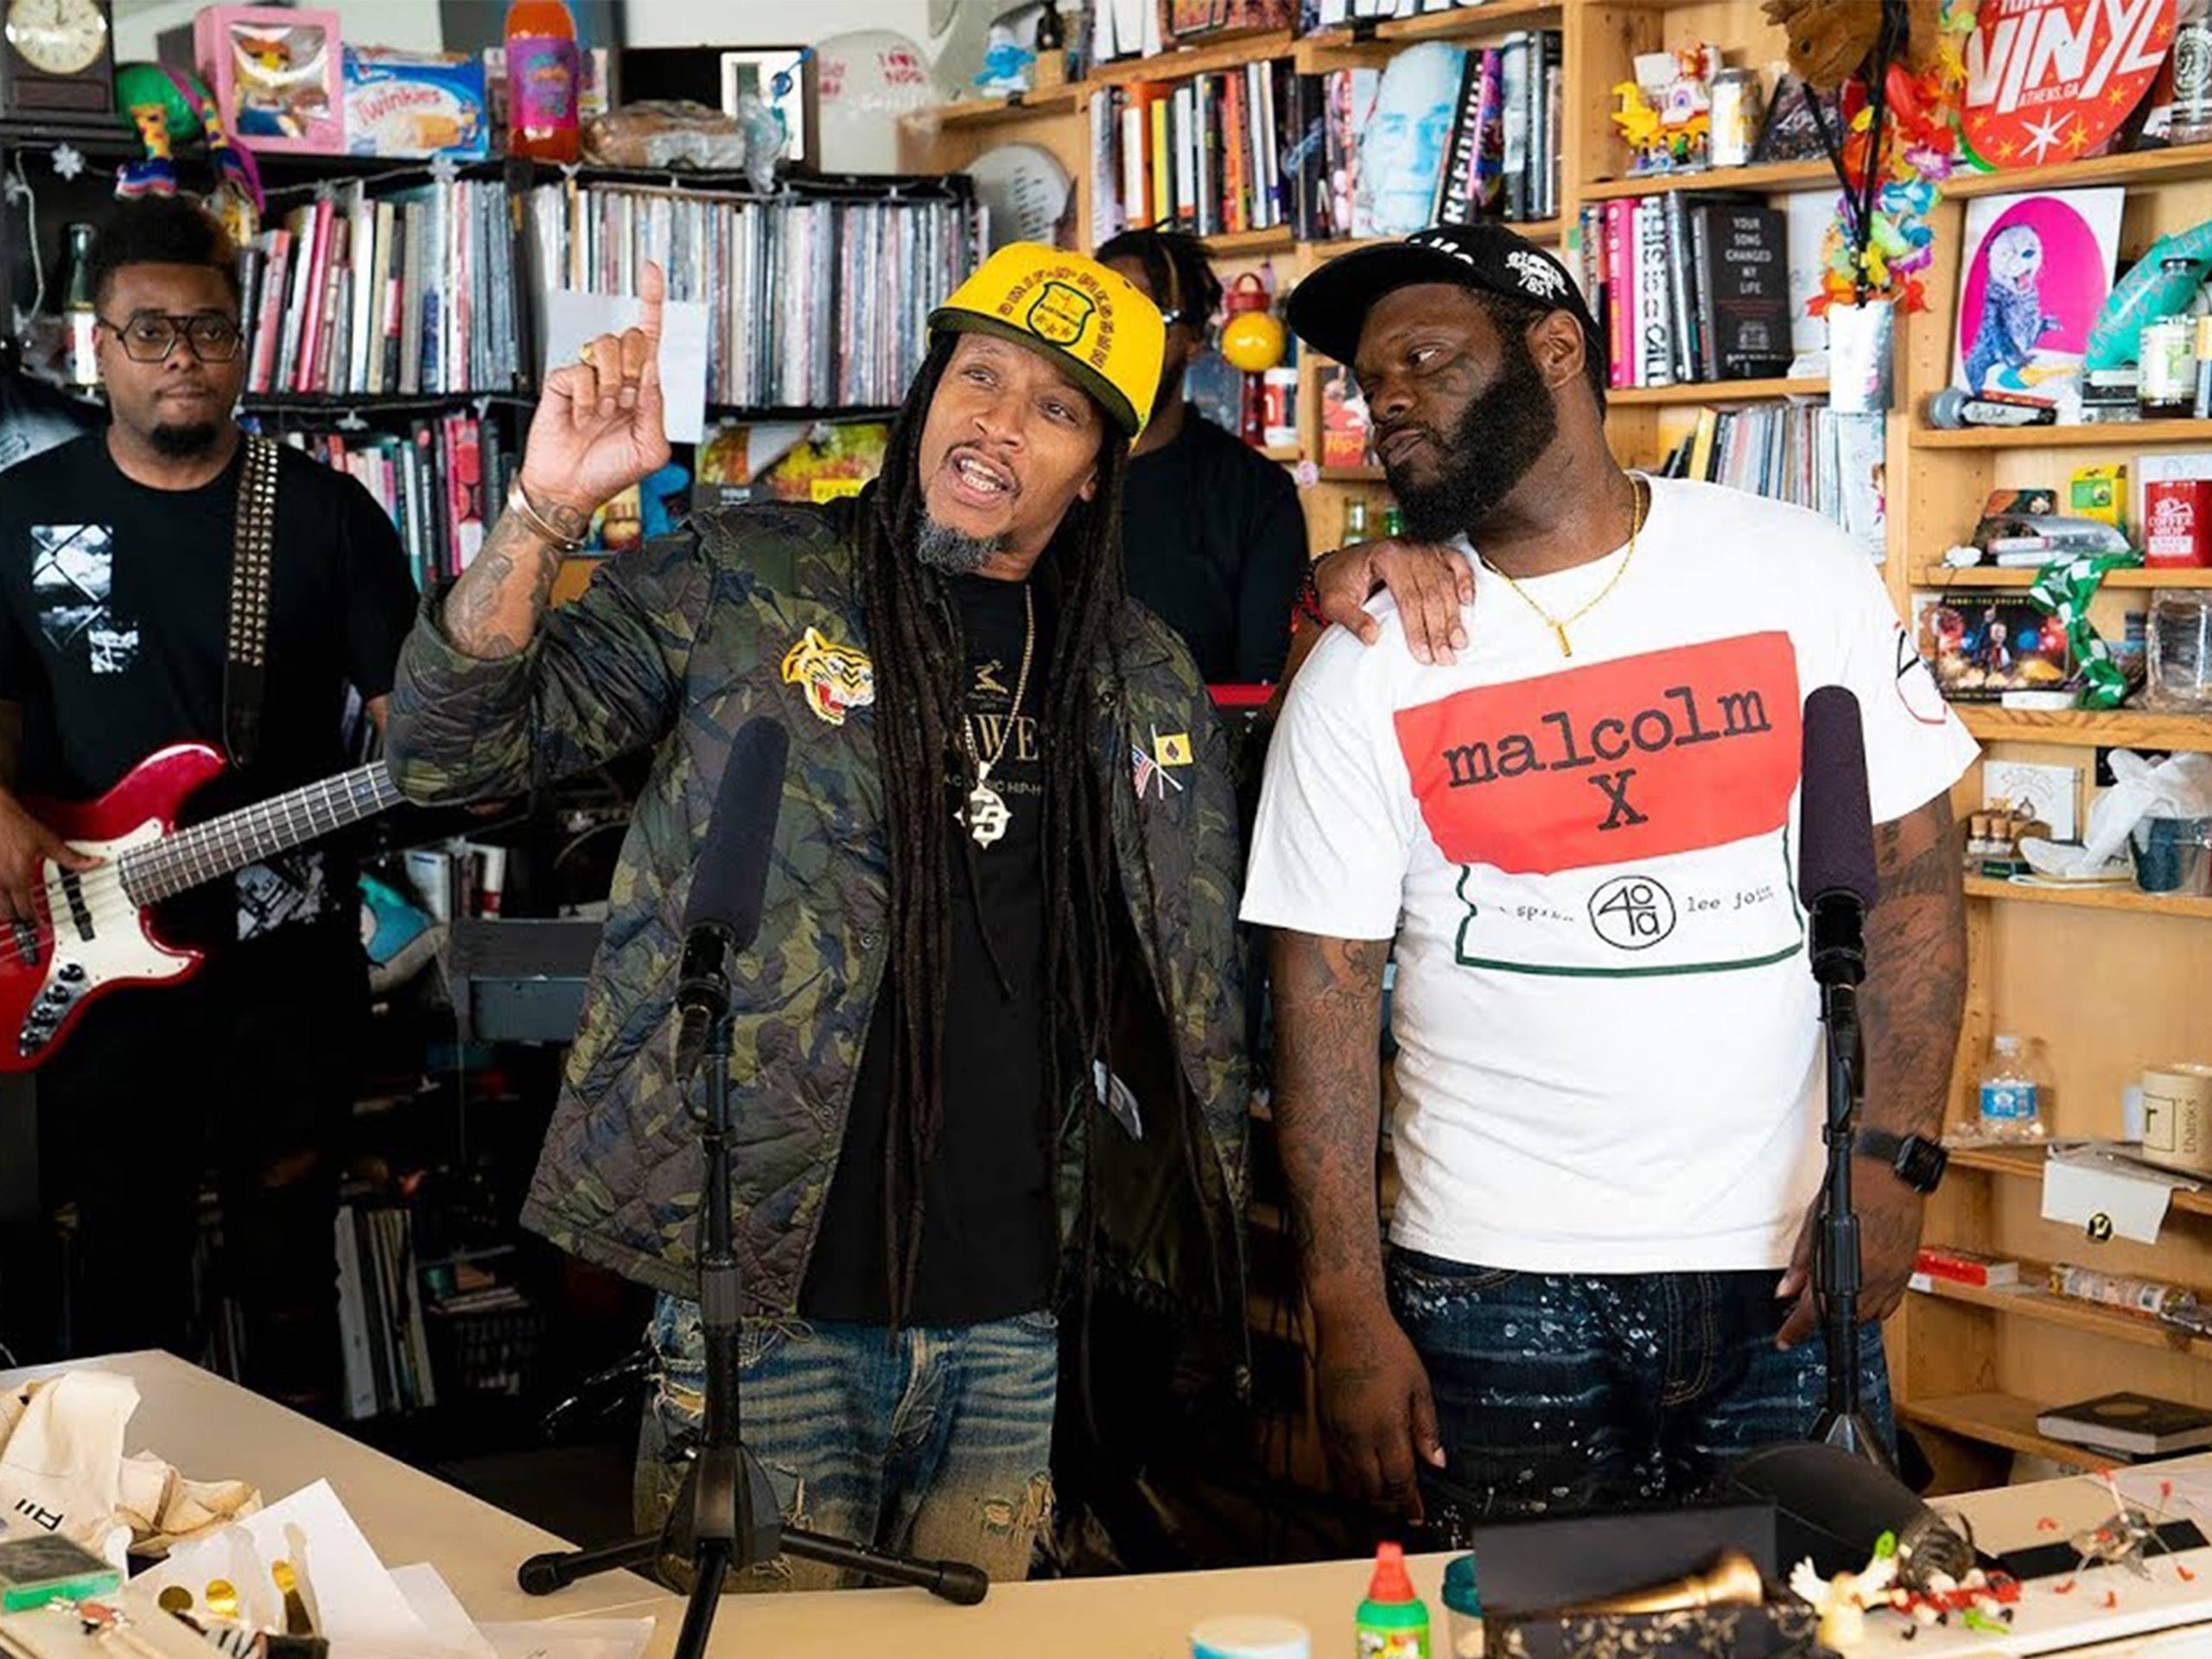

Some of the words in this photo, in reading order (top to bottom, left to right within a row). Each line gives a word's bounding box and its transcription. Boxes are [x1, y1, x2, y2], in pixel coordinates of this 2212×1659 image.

[1967, 0, 2167, 114] VINYL
[1733, 218, 1760, 229] YOUR
[1733, 233, 1762, 246] SONG
[1725, 249, 1772, 262] CHANGED
[1739, 283, 1763, 295] LIFE
[1443, 685, 1772, 788] malcolm
[1588, 769, 1649, 831] X
[1687, 896, 1721, 912] lee
